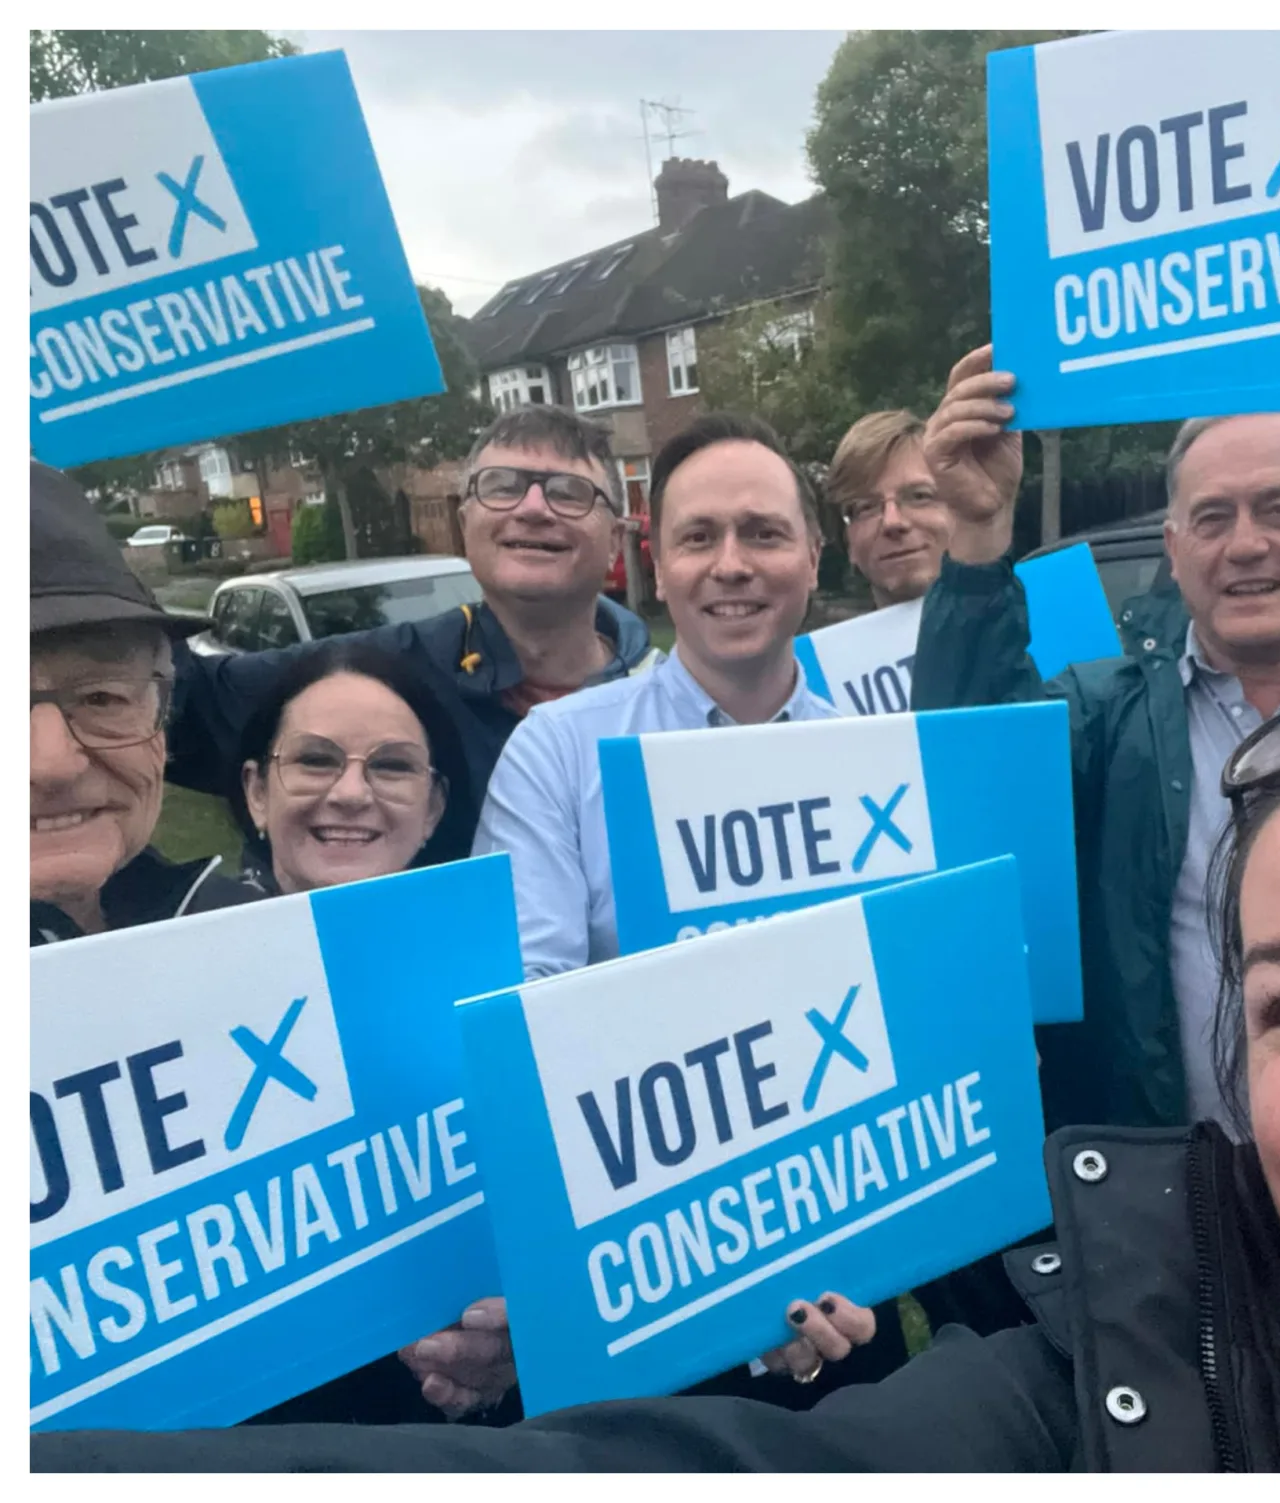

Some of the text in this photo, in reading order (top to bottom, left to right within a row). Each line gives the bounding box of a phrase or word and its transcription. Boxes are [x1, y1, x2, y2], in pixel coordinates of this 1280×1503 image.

[30, 177, 158, 296] OTE
[1066, 100, 1252, 233] VOTE
[676, 796, 840, 893] VOTE
[30, 1040, 207, 1224] OTE
[576, 1020, 789, 1191] VOTE
[30, 1098, 477, 1377] NSERVATIVE
[587, 1071, 991, 1323] CONSERVATIVE
